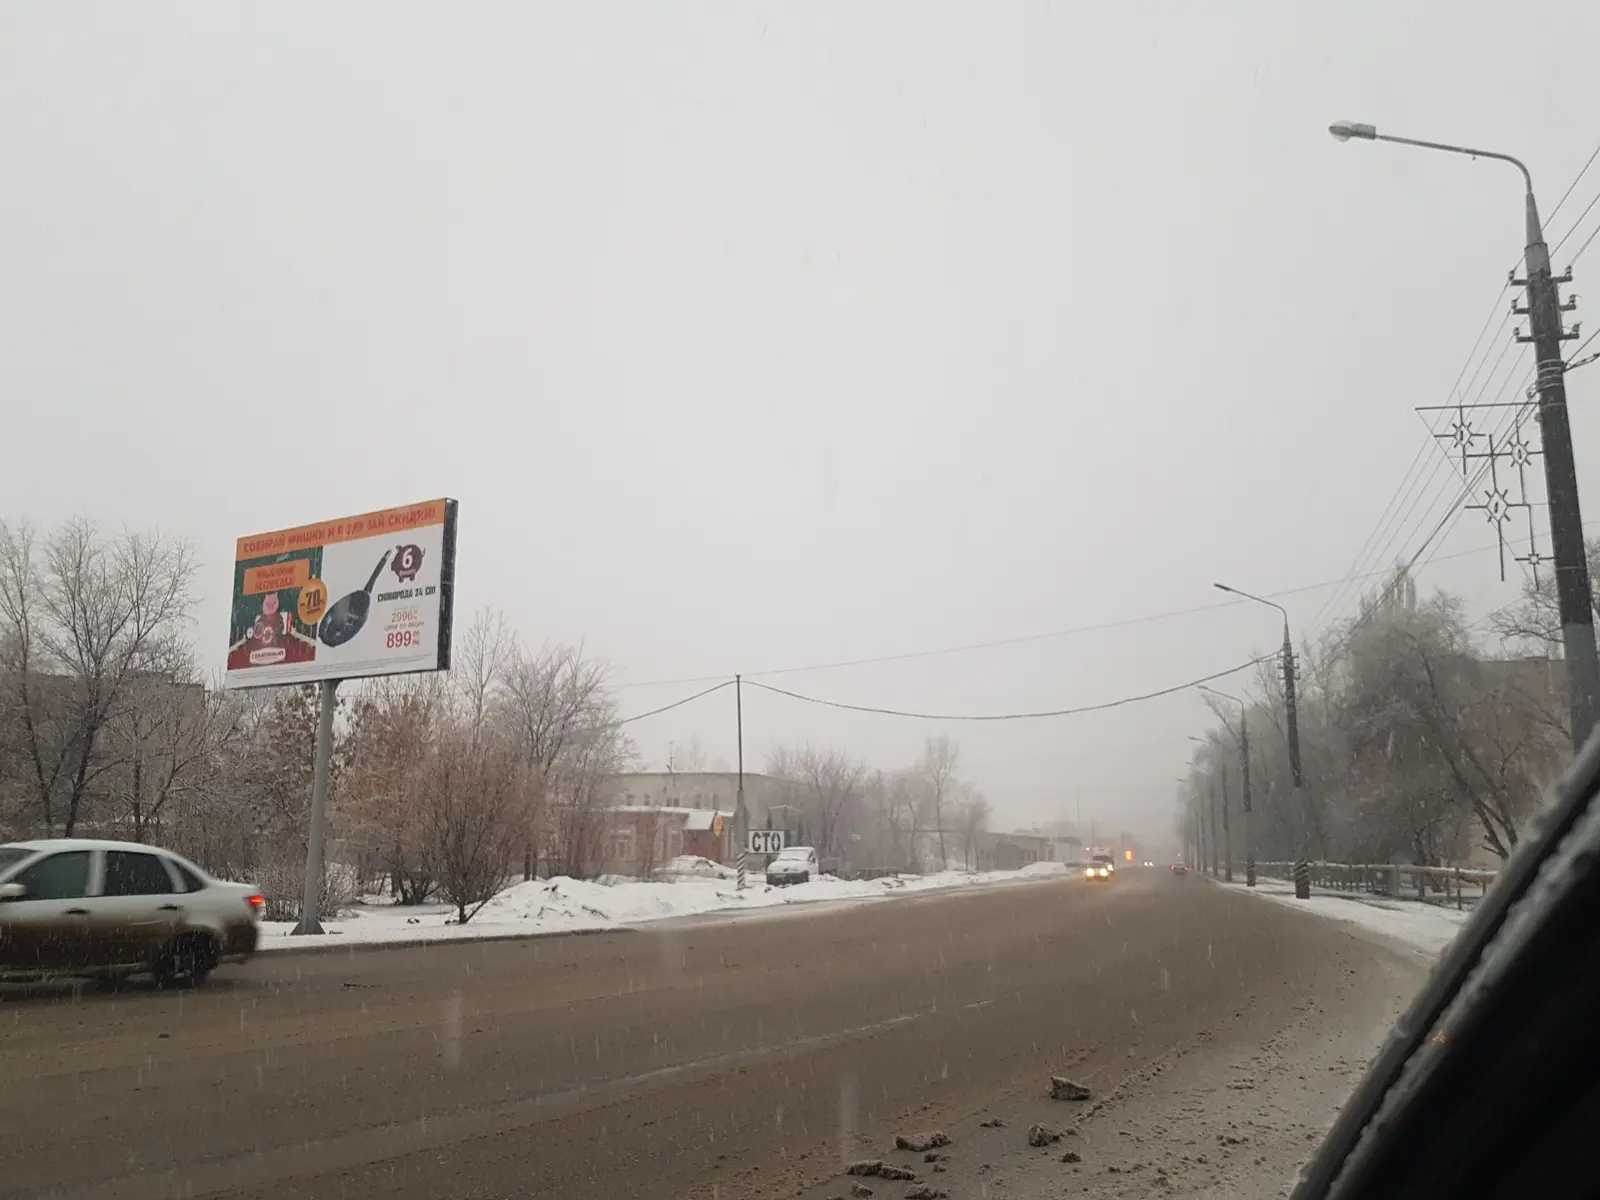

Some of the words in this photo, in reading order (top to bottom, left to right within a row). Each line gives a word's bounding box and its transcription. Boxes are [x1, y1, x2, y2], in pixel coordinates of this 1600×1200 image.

[402, 548, 413, 569] 6
[415, 586, 424, 597] 24
[386, 630, 412, 648] 899
[752, 832, 781, 852] СТО
